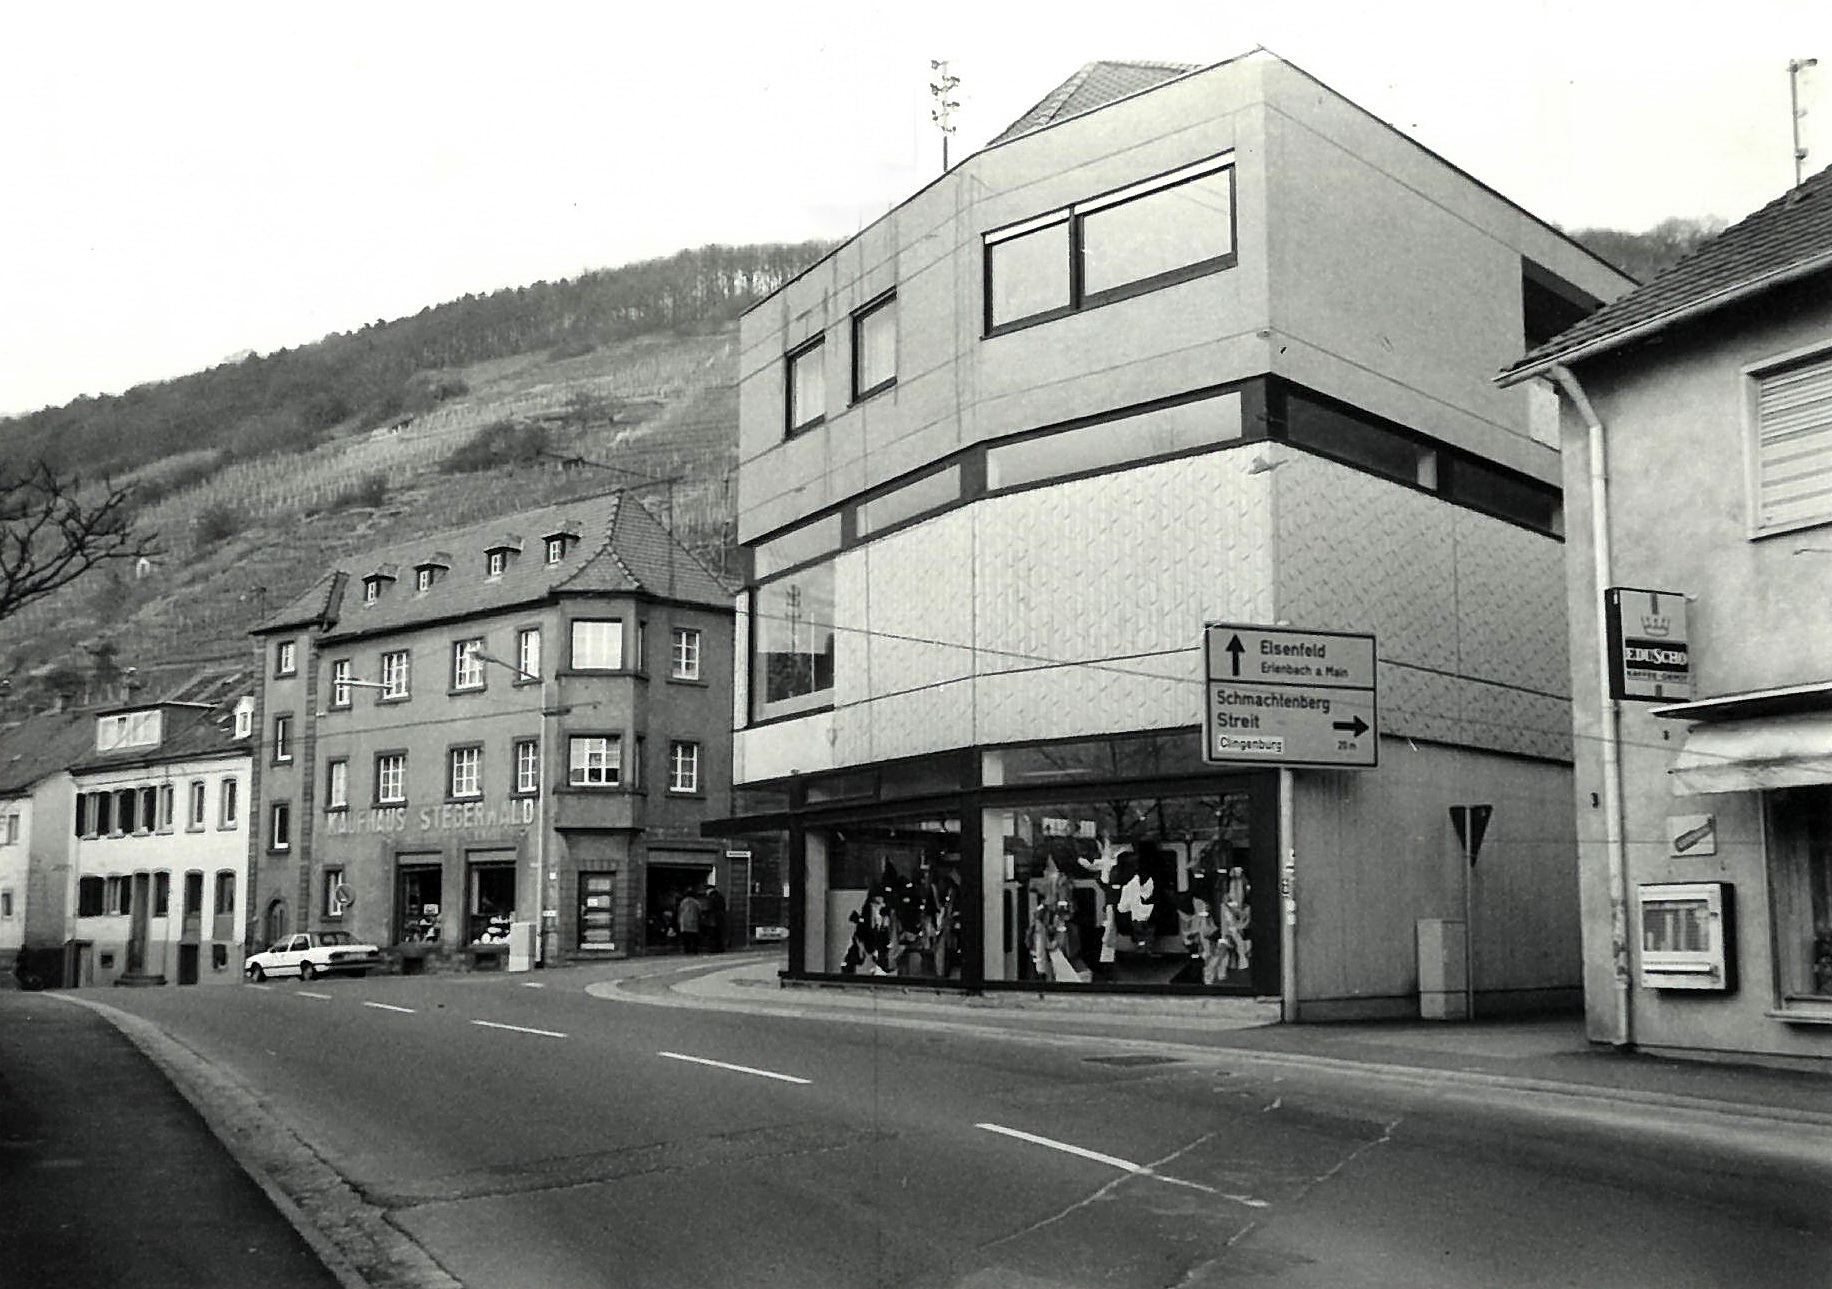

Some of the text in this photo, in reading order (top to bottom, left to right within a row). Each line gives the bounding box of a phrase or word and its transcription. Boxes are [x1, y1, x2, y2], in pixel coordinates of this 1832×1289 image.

[1261, 662, 1312, 677] Erlenbach
[1325, 667, 1349, 678] Main
[1216, 690, 1331, 714] Schmachtenberg
[1217, 713, 1260, 729] Streit
[328, 800, 534, 836] KAUFHAUS STEGERWALD
